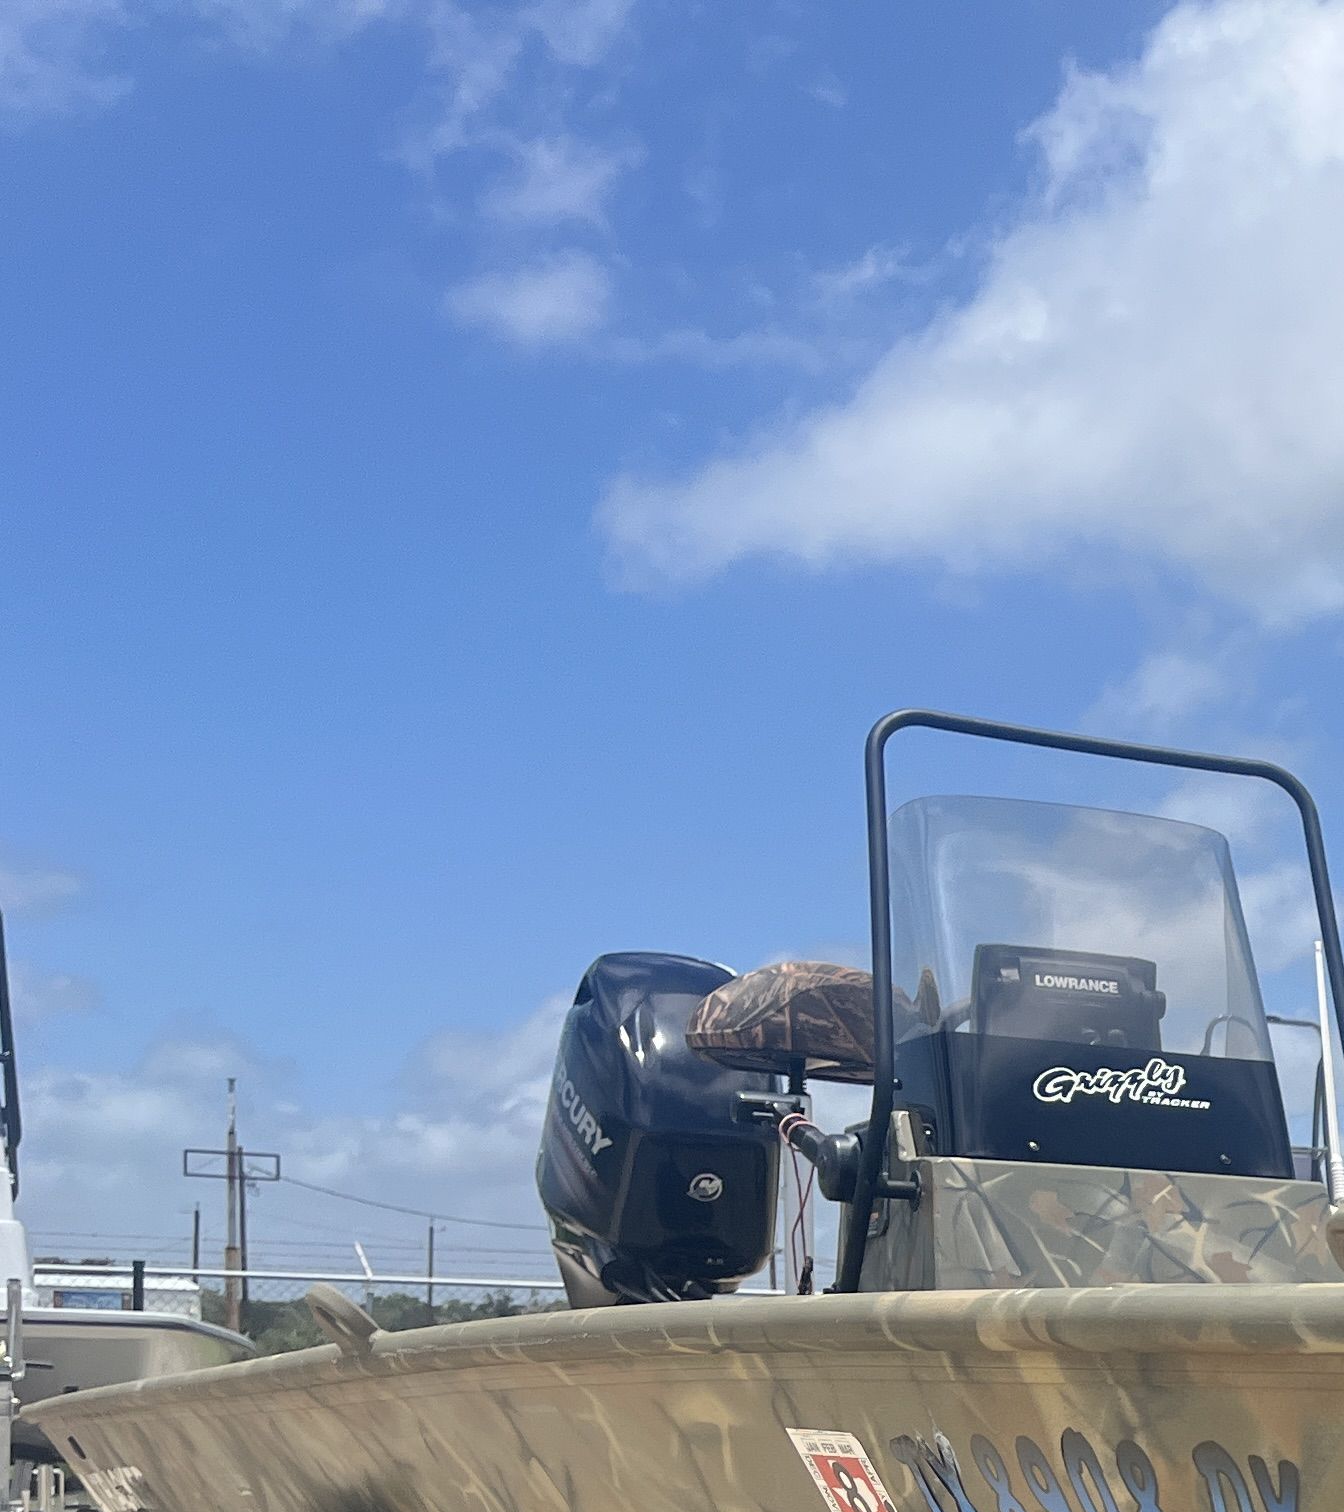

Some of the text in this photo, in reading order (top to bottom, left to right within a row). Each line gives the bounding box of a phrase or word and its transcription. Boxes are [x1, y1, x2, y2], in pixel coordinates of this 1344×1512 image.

[1034, 974, 1120, 994] LOWRANCE
[1032, 1058, 1187, 1104] Grizzly
[1147, 1090, 1163, 1098] BY
[555, 1060, 613, 1155] RCURY
[1141, 1096, 1211, 1110] TRACKER
[821, 1442, 838, 1454] FEB
